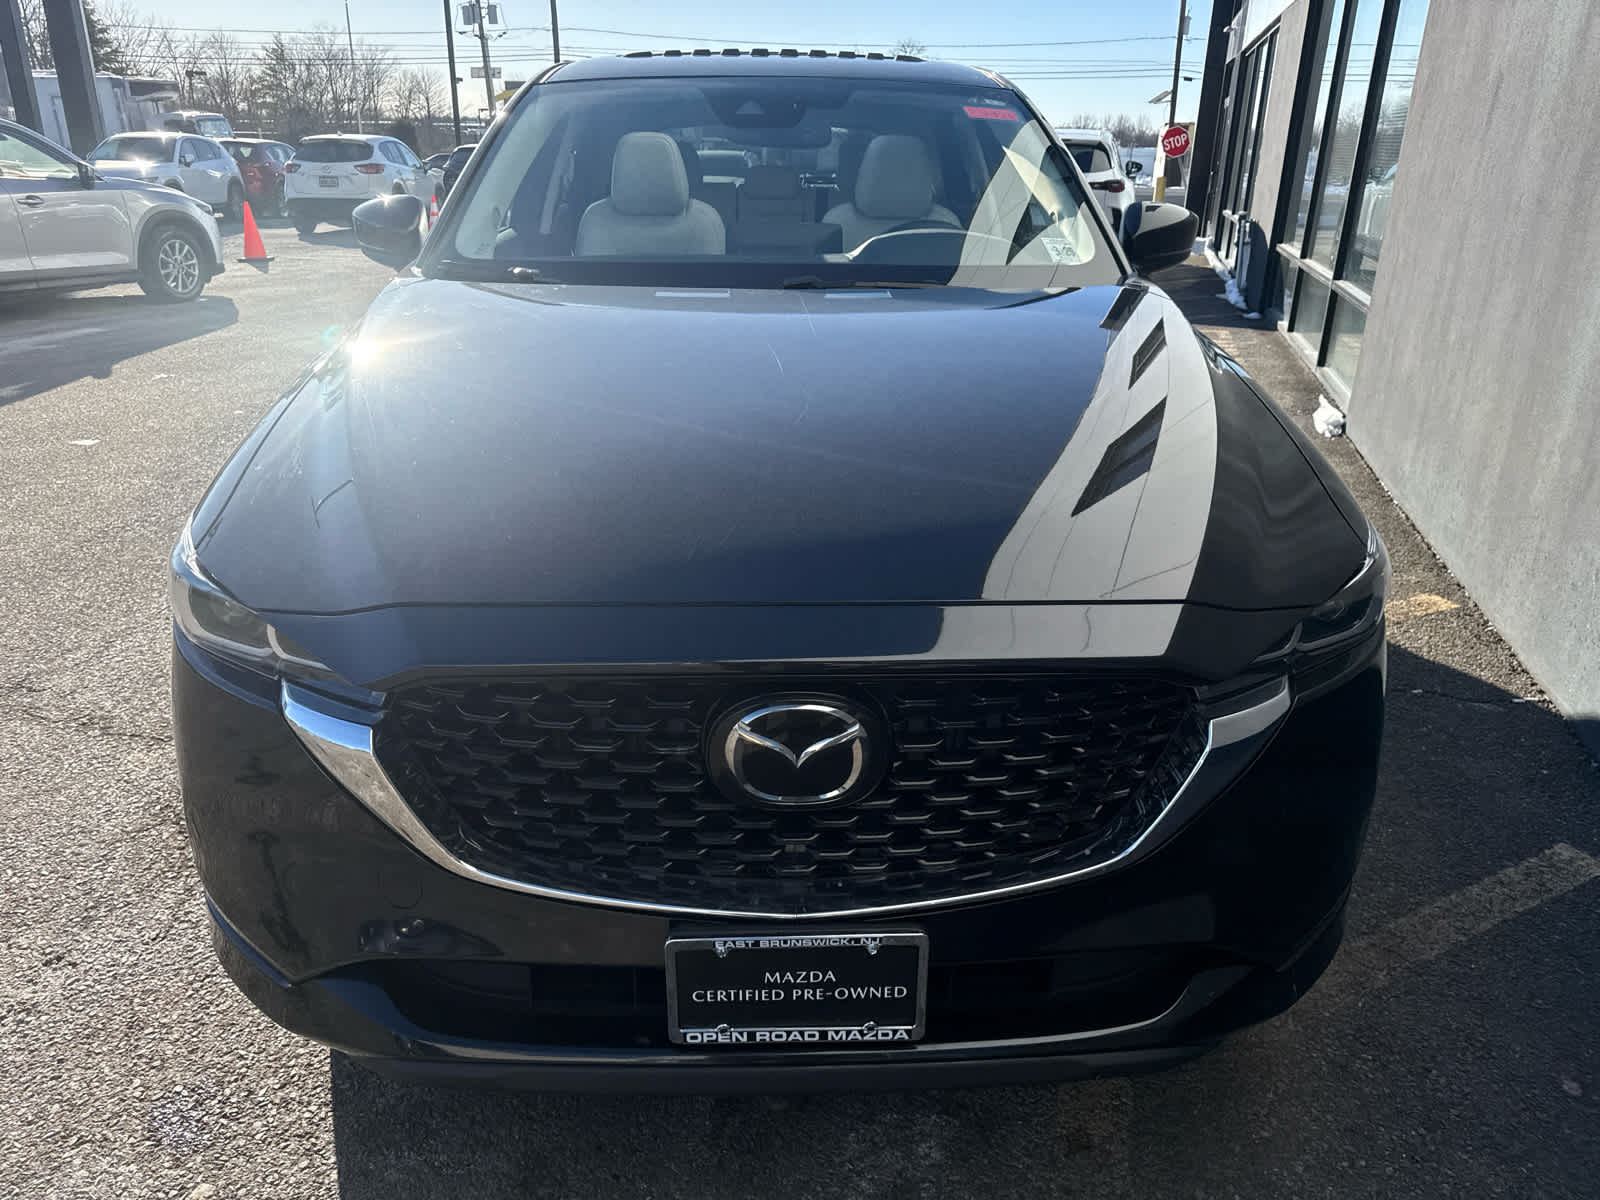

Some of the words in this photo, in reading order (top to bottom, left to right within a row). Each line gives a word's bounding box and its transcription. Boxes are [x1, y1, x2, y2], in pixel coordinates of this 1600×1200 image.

[1163, 133, 1188, 151] STOP
[714, 940, 755, 949] EAST
[860, 937, 880, 945] NJ
[764, 970, 836, 984] MAZDA
[692, 989, 785, 1003] CERTIFIED
[792, 986, 908, 1001] PRE-OWNED
[686, 1031, 747, 1043] OPEN
[755, 1030, 820, 1042] ROAD
[827, 1028, 910, 1041] MAZDA
